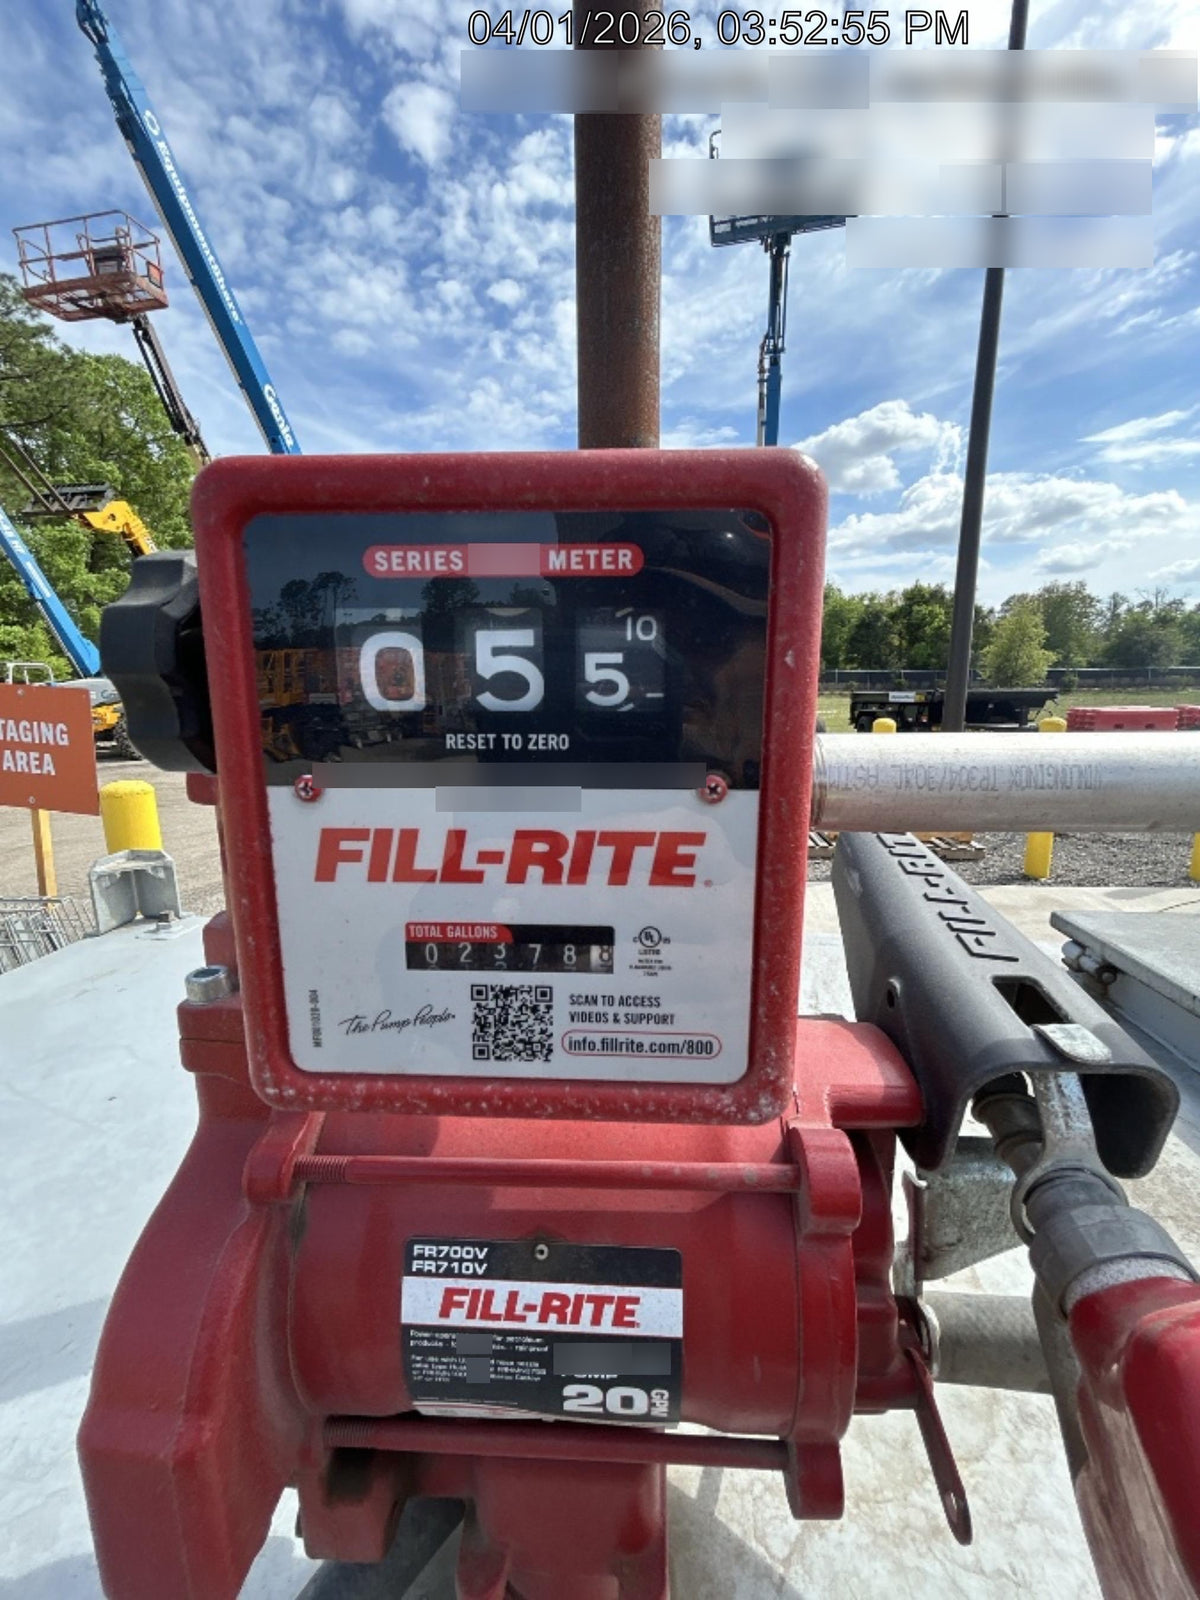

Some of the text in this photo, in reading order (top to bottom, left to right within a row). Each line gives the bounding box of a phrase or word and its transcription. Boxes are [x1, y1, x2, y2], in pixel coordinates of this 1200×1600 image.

[374, 548, 633, 572] SERIES METER
[446, 734, 569, 750] RESET TO ZERO
[3, 750, 56, 776] AREA
[314, 827, 707, 887] FILL-RITE
[409, 925, 498, 939] TOTAL GALLONS
[569, 994, 661, 1008] SCAN TO ACCESS
[338, 1015, 369, 1035] The
[371, 1009, 412, 1034] Pump
[568, 1011, 675, 1025] VIDEOS & SUPPORT
[568, 1036, 713, 1055] info.fillrite.com/800
[413, 1245, 488, 1259] FR700V
[412, 1260, 488, 1274] FR710V
[438, 1287, 640, 1328] FILL-RITE
[563, 1384, 648, 1415] 20
[650, 1389, 669, 1417] GPM
